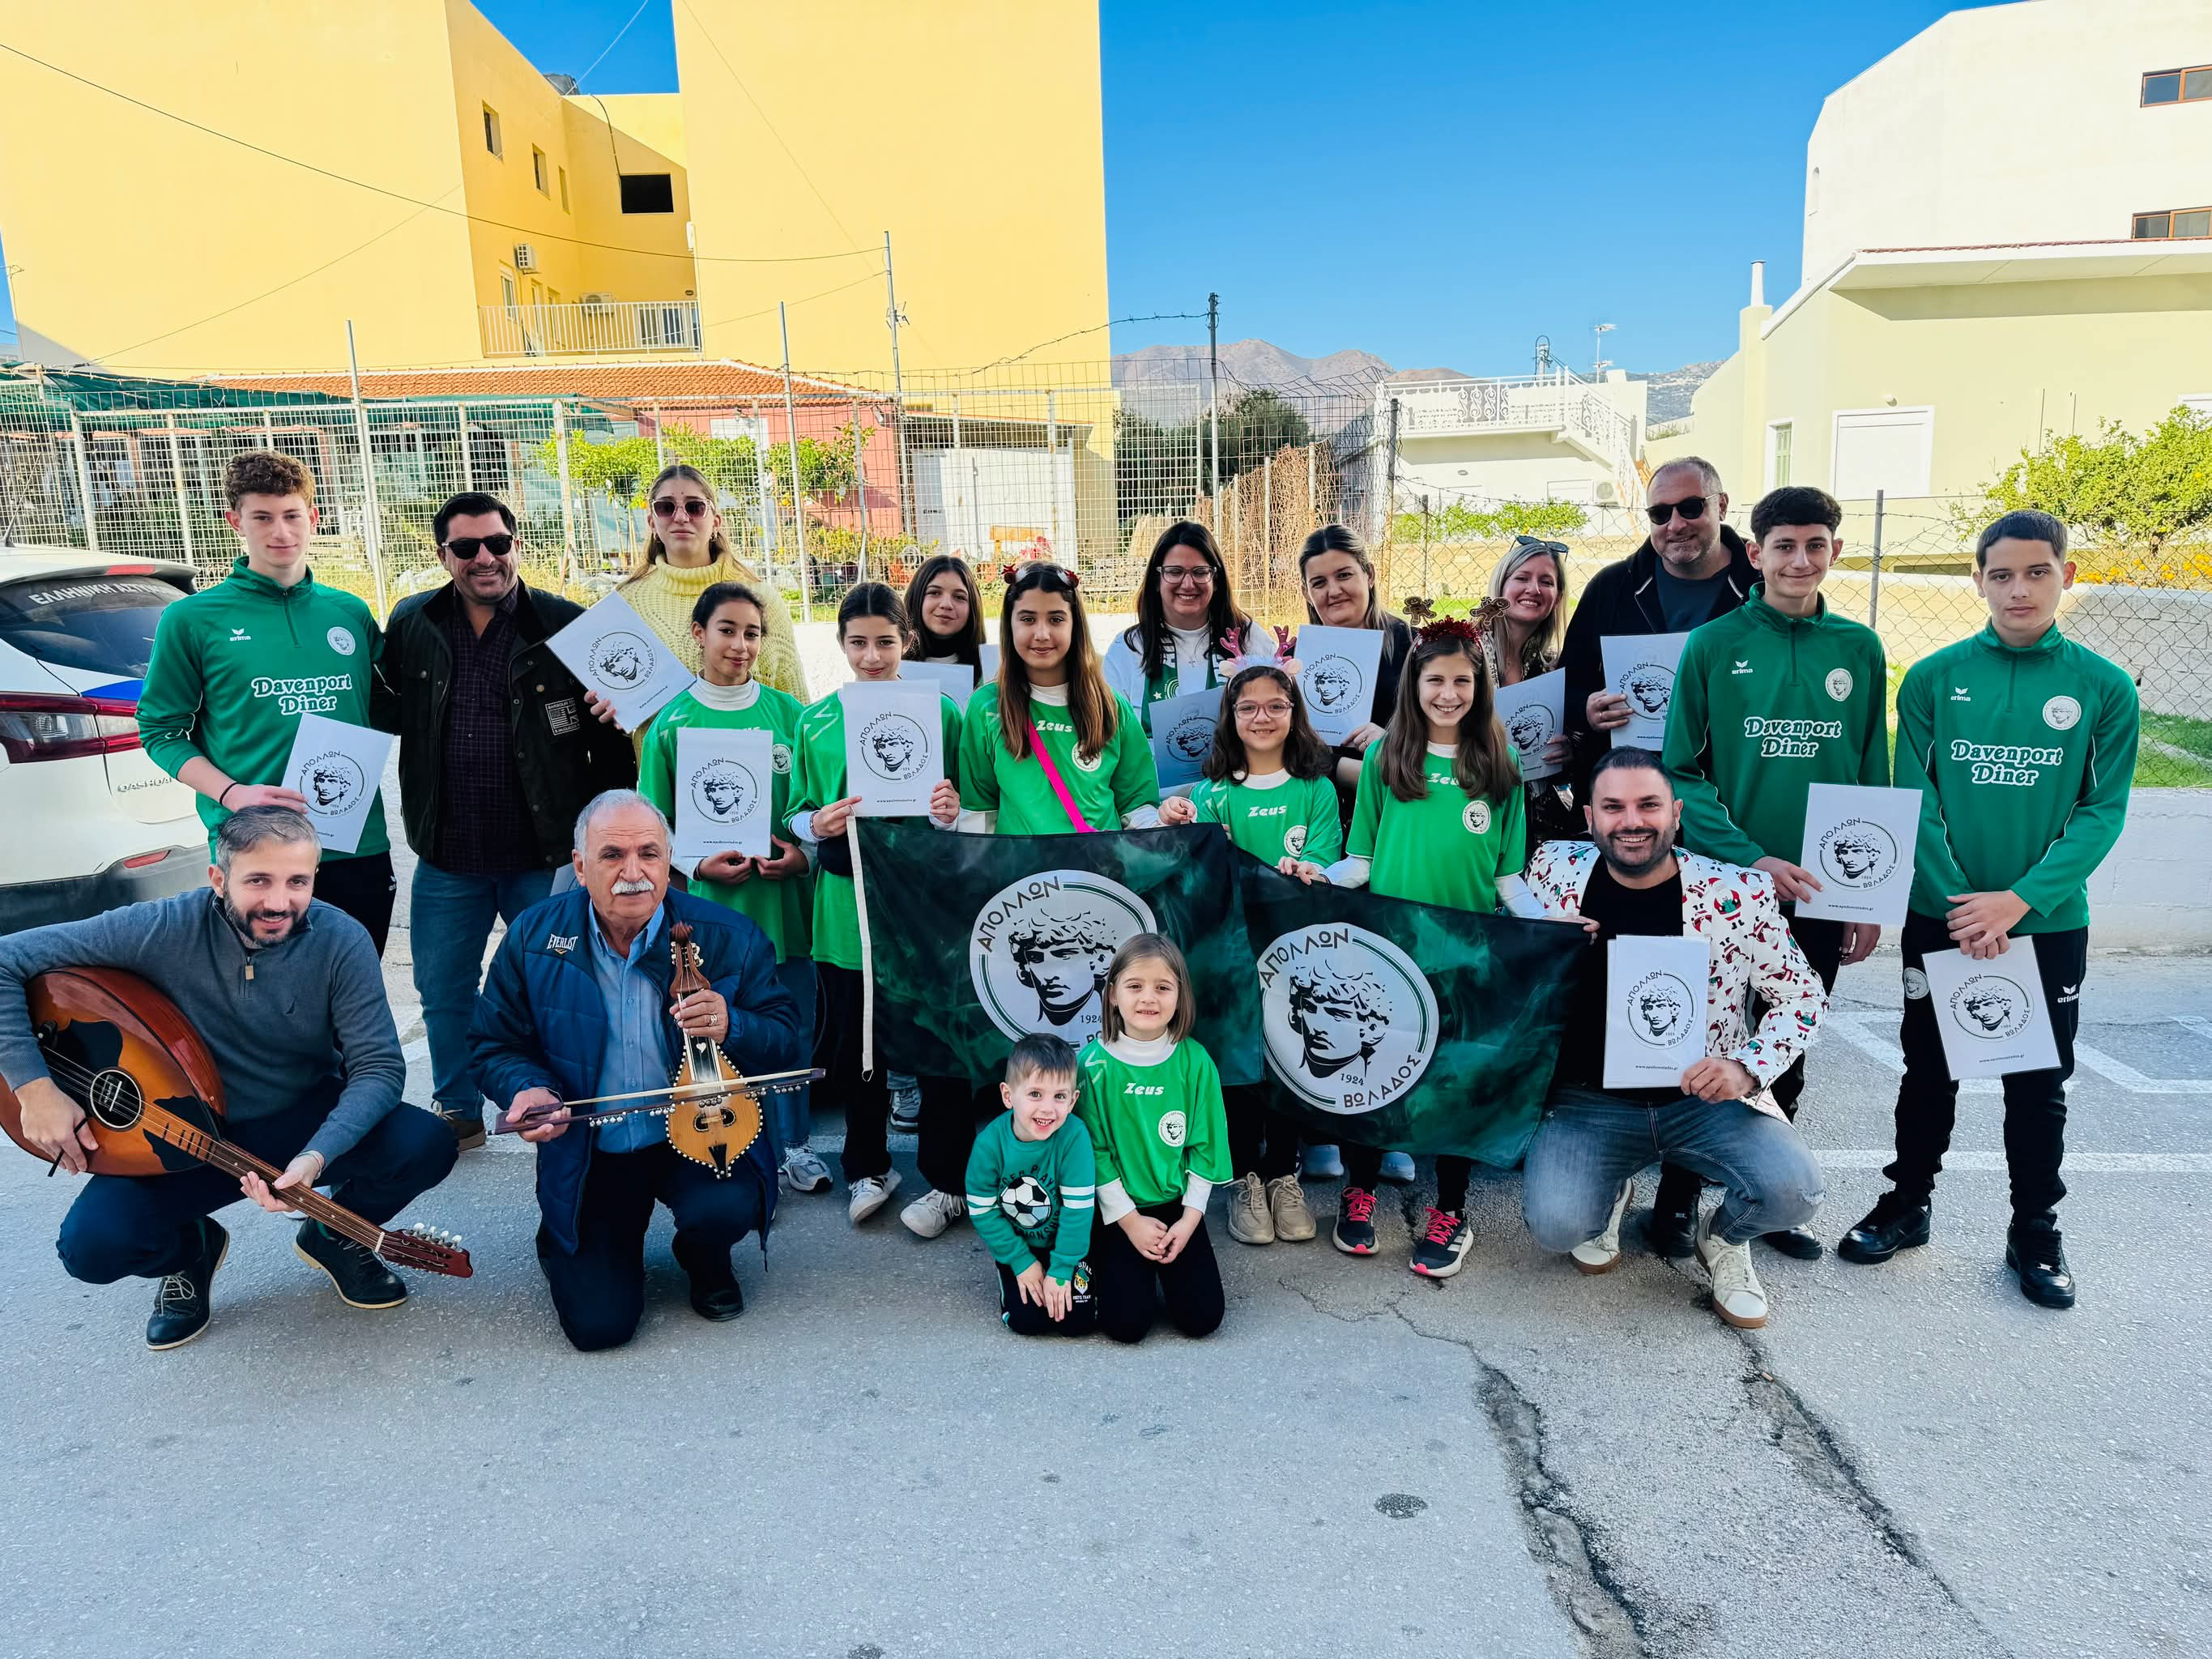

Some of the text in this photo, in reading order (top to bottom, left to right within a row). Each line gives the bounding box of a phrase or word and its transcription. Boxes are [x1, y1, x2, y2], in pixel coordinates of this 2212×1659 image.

[28, 582, 118, 605] ΕΛΛΗΝΙΚΗ
[588, 637, 602, 677] ΑΠΟΛΛΩΝ
[1302, 652, 1337, 681] ΑΠΟΛΛΩΝ
[252, 674, 352, 697] Davenport
[1619, 661, 1649, 690] ΑΠΟΛΛΩΝ
[279, 695, 337, 714] Diner
[1950, 694, 1971, 702] erima
[859, 710, 893, 746] ΑΠΟΛΛΩΝ
[1035, 719, 1073, 733] Zeus
[1505, 703, 1529, 727] ΟΛΛΩΝ
[1745, 716, 1843, 740] Davenport
[1761, 736, 1819, 757] Diner
[1951, 740, 2064, 767] Davenport
[300, 750, 341, 776] ΑΠΟΛΛΩΝ
[690, 757, 725, 789] ΑΠΟΛΛΩΝ
[903, 753, 928, 780] ΒΩΛΑΔΟΣ
[1971, 762, 2039, 786] Diner
[731, 800, 758, 824] ΒΩΛΑΔΟΣ
[1247, 805, 1287, 817] Zeus
[1818, 817, 1861, 850] ΑΠΟΛΛΩΝ
[1862, 864, 1895, 889] ΒΩΛΑΔΟΣ
[977, 876, 1061, 953] ΑΠΟΛΛΩΝ
[1259, 928, 1349, 988] ΑΠΟΛΛΩΝ
[1626, 969, 1663, 1006] ΑΠΟΛΛΩΝ
[1950, 973, 1984, 1011] ΑΠΟΛΛΩΝ
[1667, 1017, 1694, 1047] ΒΩΛΑΔΟΣ
[2005, 1008, 2031, 1038] ΒΩΛΑΔΟΣ
[1123, 1082, 1165, 1096] Zeus
[1340, 1072, 1366, 1086] 1924
[1343, 1054, 1421, 1108] ΒΩΛΑΔΟΣ
